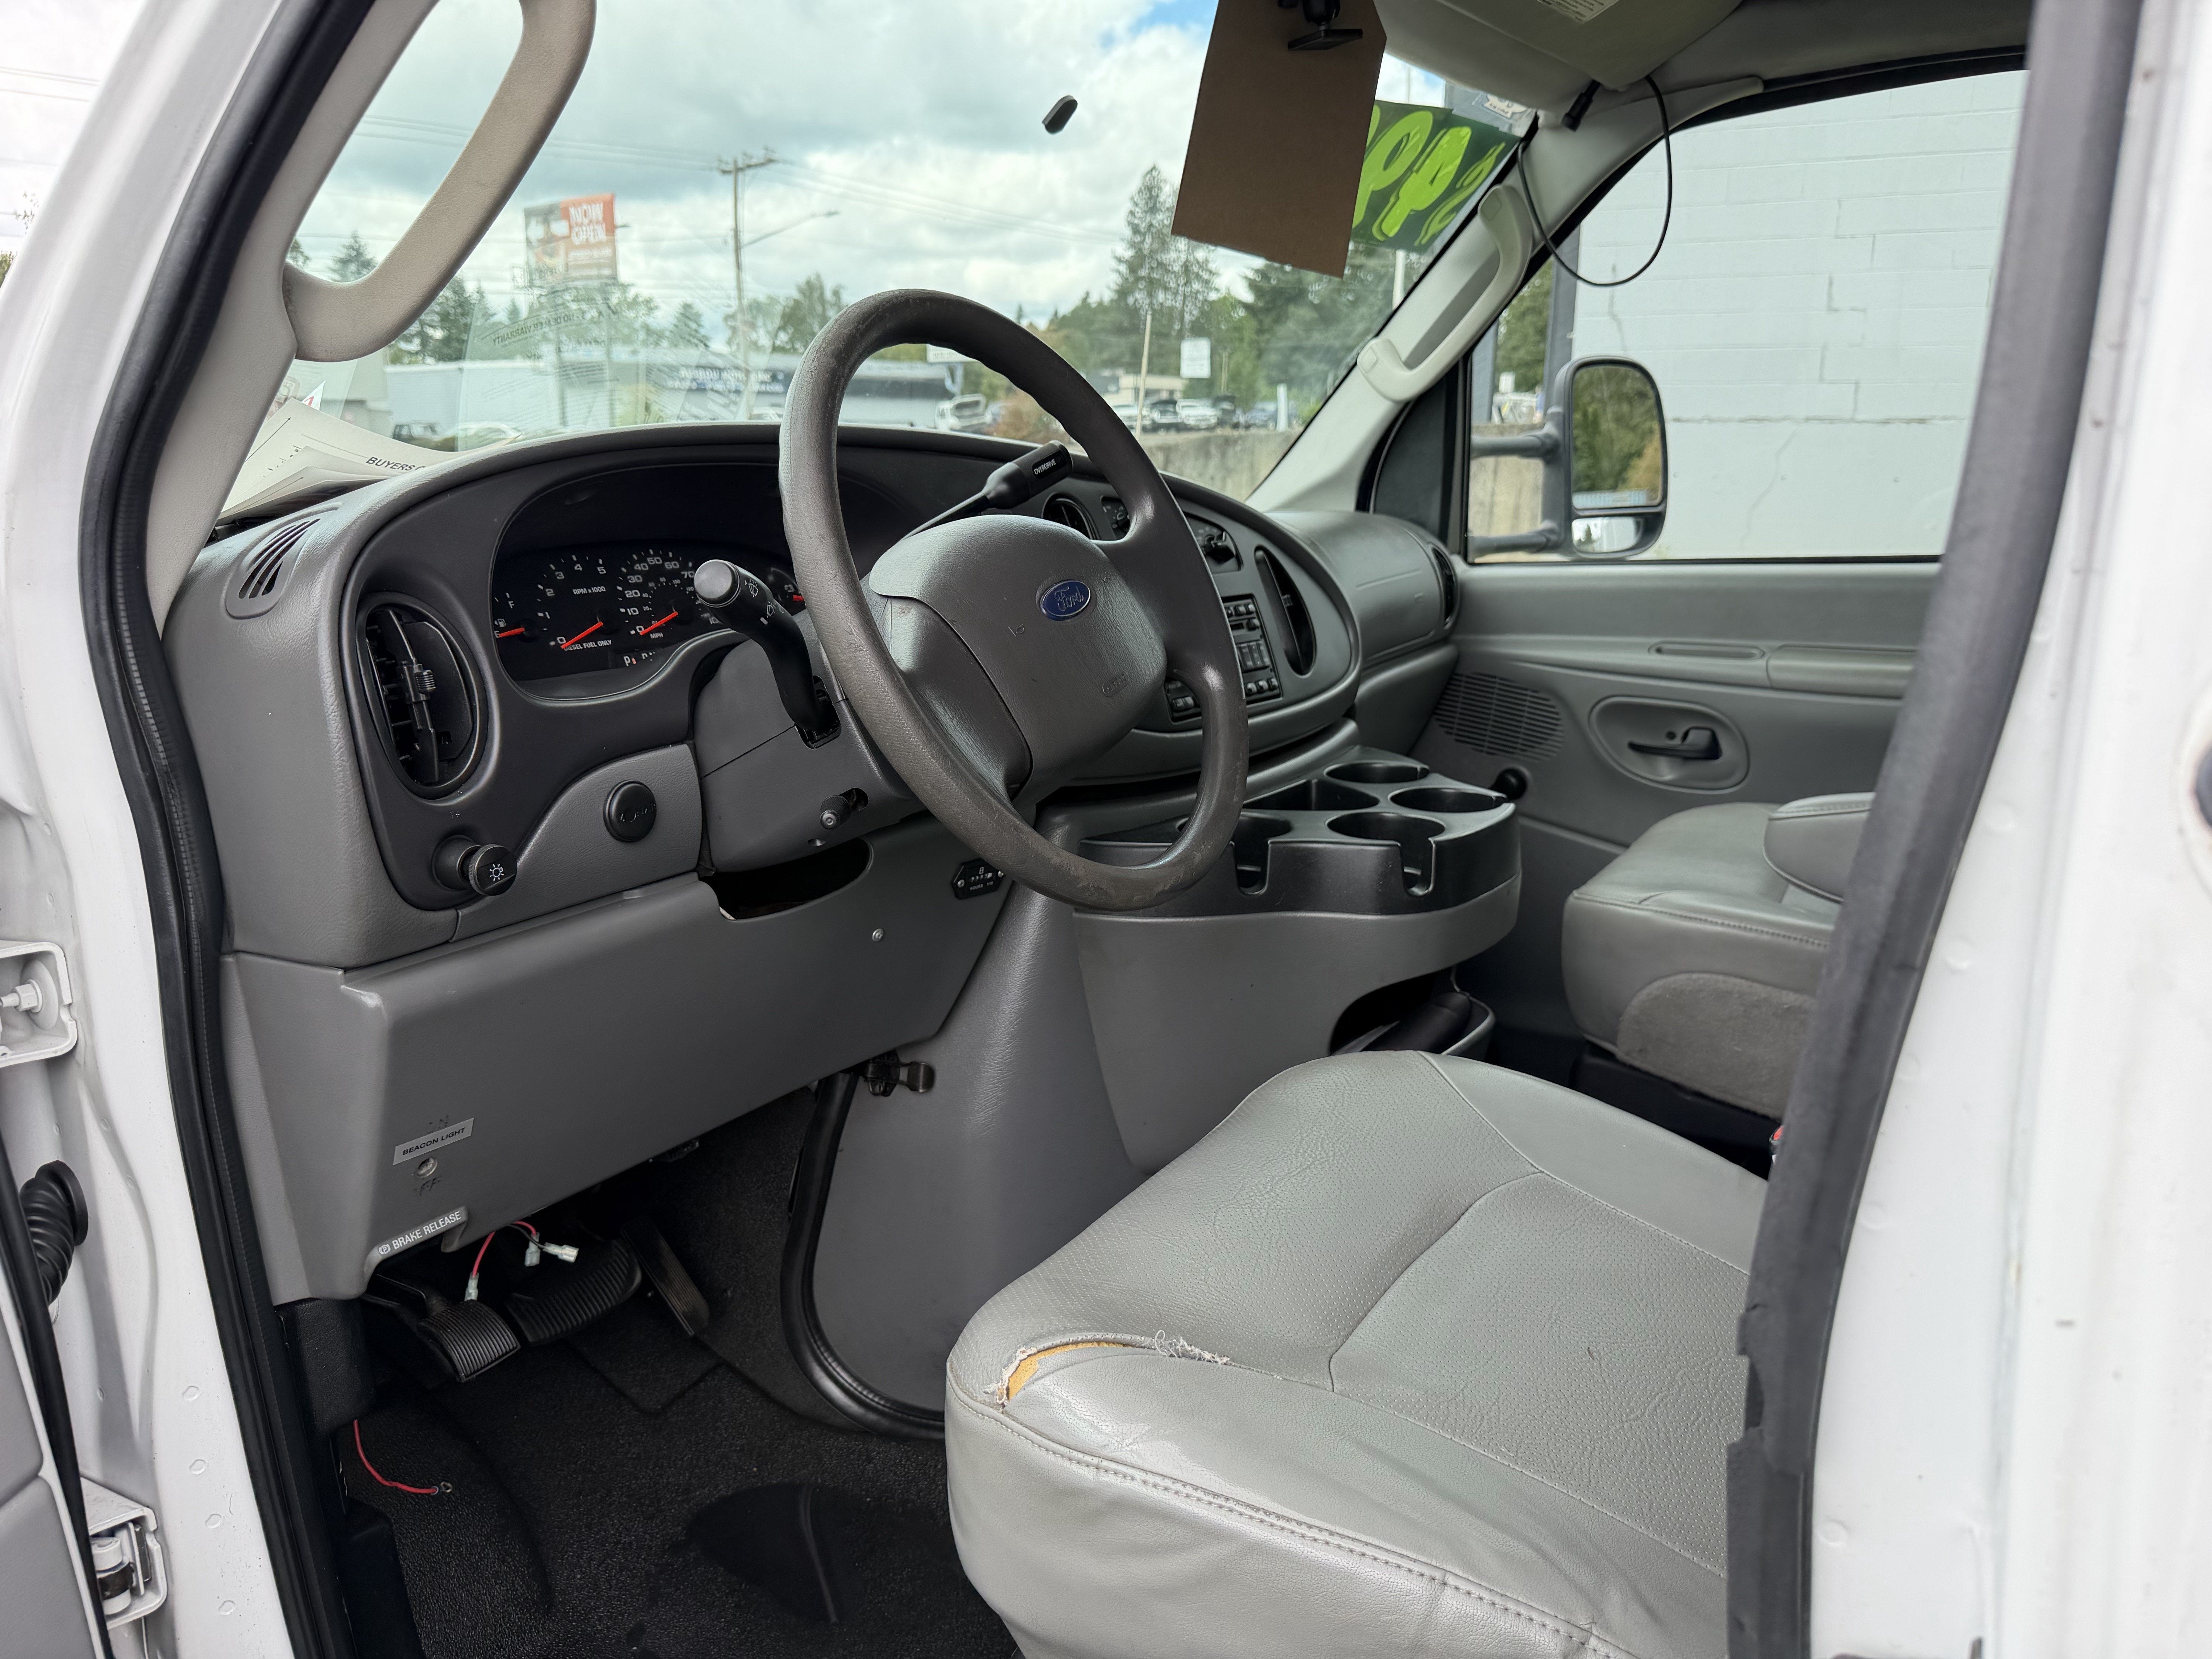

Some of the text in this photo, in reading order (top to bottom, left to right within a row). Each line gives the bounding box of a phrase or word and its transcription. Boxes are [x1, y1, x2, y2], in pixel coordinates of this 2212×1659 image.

[569, 203, 603, 226] NOW
[366, 457, 416, 471] BUYERS
[1034, 459, 1056, 475] OVERDRIVE
[627, 575, 643, 583] 30
[508, 601, 515, 609] F
[1054, 586, 1084, 612] Ford
[598, 639, 612, 647] ONLY
[623, 656, 631, 666] P
[402, 1127, 466, 1156] BEACON LIGHT
[392, 1229, 423, 1250] BRAKE
[423, 1211, 462, 1235] RELEASE
